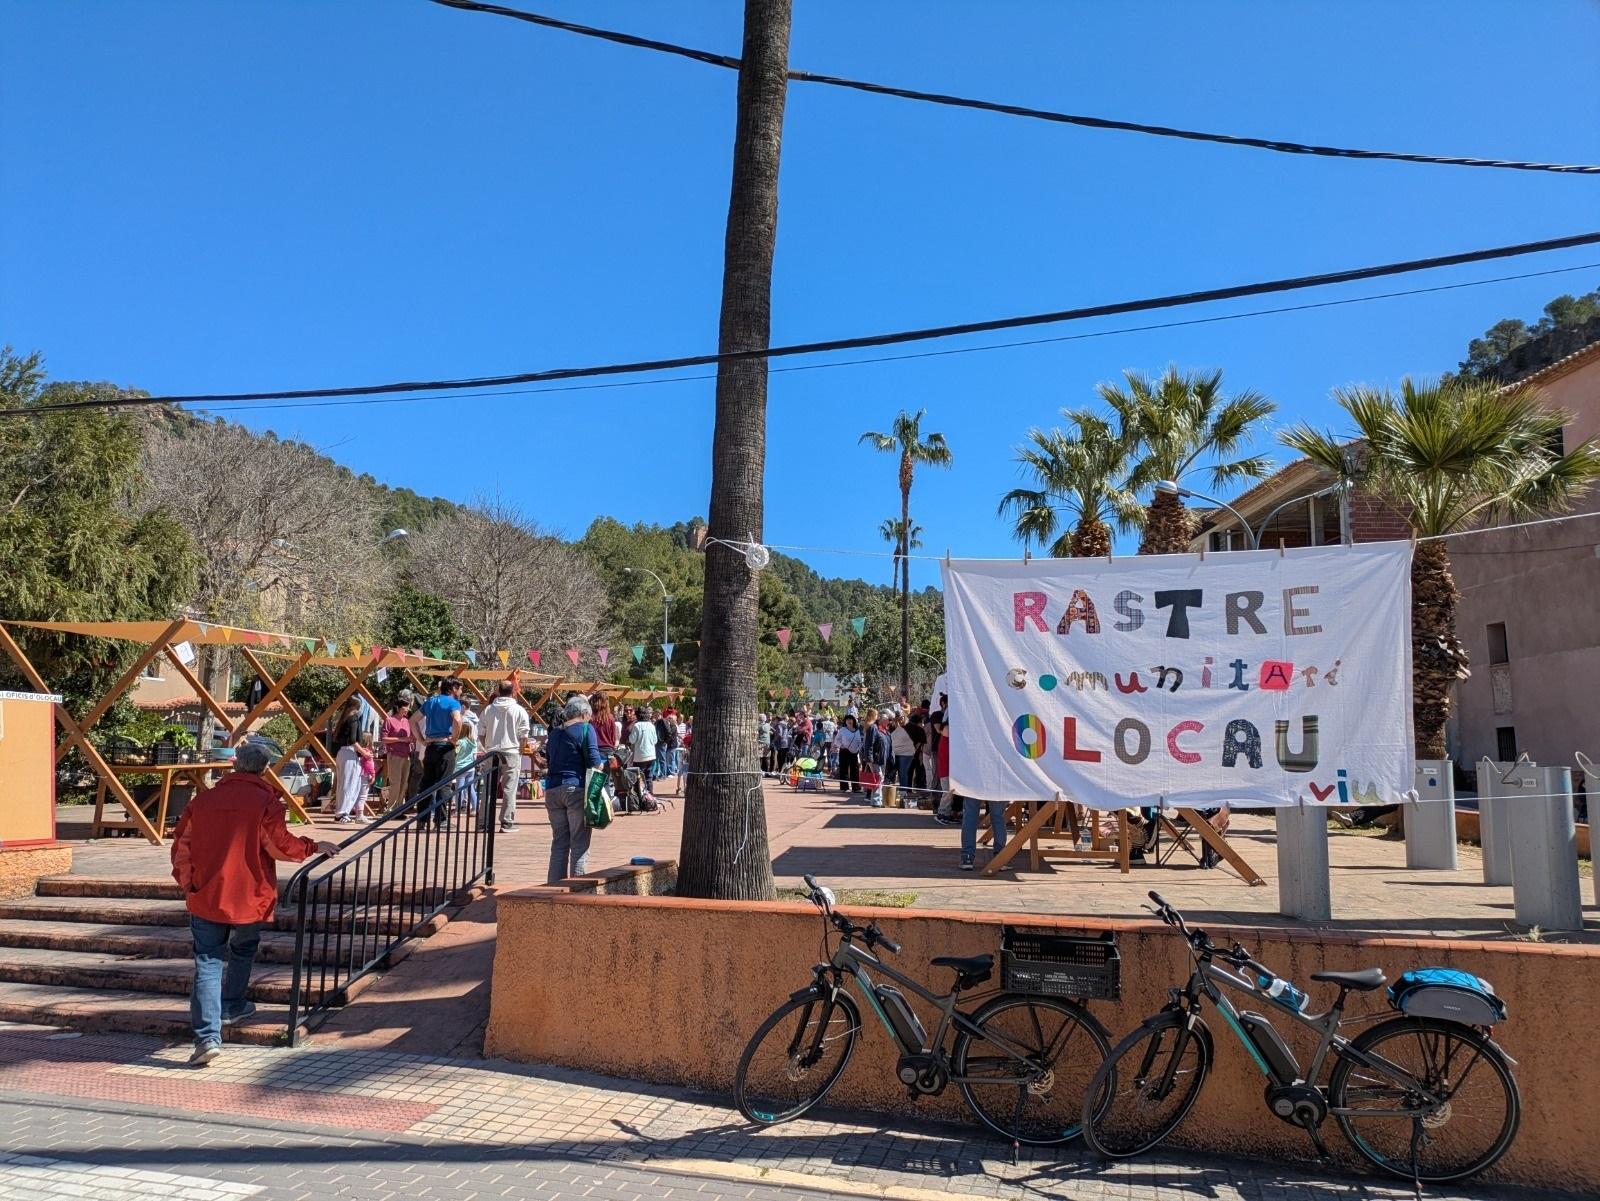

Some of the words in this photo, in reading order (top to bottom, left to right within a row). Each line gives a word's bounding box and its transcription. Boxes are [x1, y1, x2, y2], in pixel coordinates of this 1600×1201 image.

[1013, 586, 1323, 639] RASTRE
[1012, 713, 1319, 772] OLOCAU
[1309, 769, 1385, 804] viu
